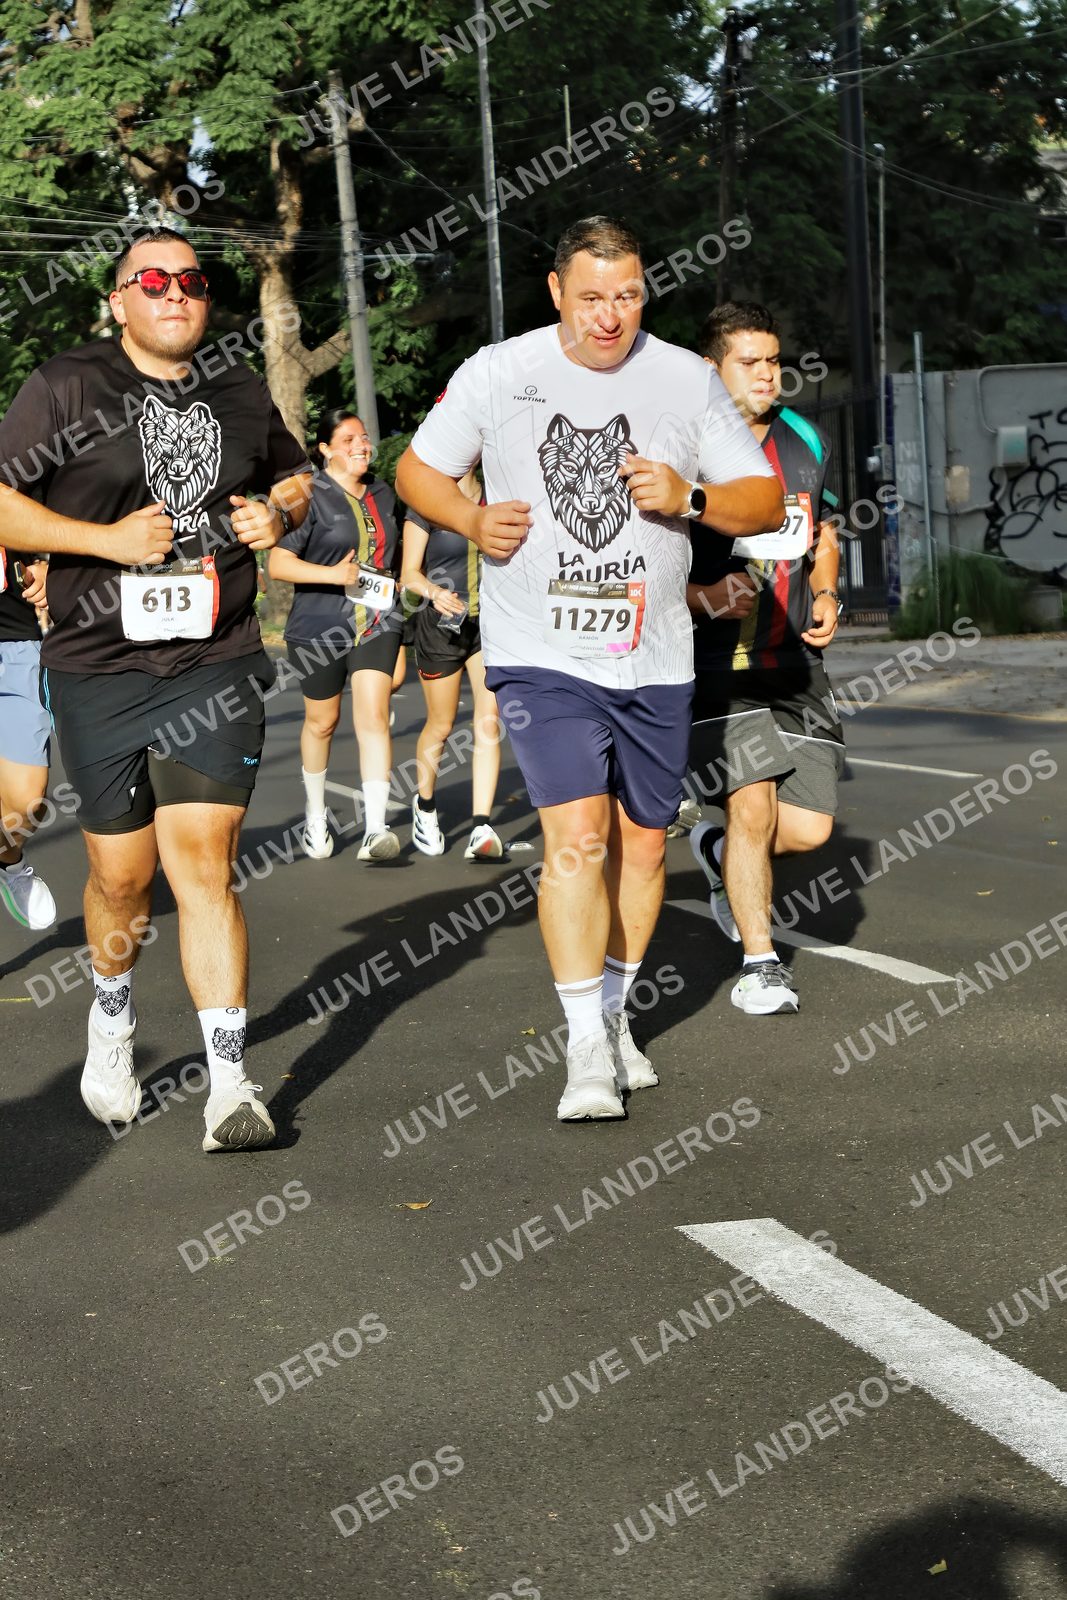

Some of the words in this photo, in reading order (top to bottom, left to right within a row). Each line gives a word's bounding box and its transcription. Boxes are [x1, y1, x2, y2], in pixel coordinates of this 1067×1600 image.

[513, 395, 547, 403] TOPTIME
[557, 551, 585, 568] LA
[358, 576, 381, 594] 996
[142, 586, 191, 612] 613
[551, 606, 631, 632] 11279
